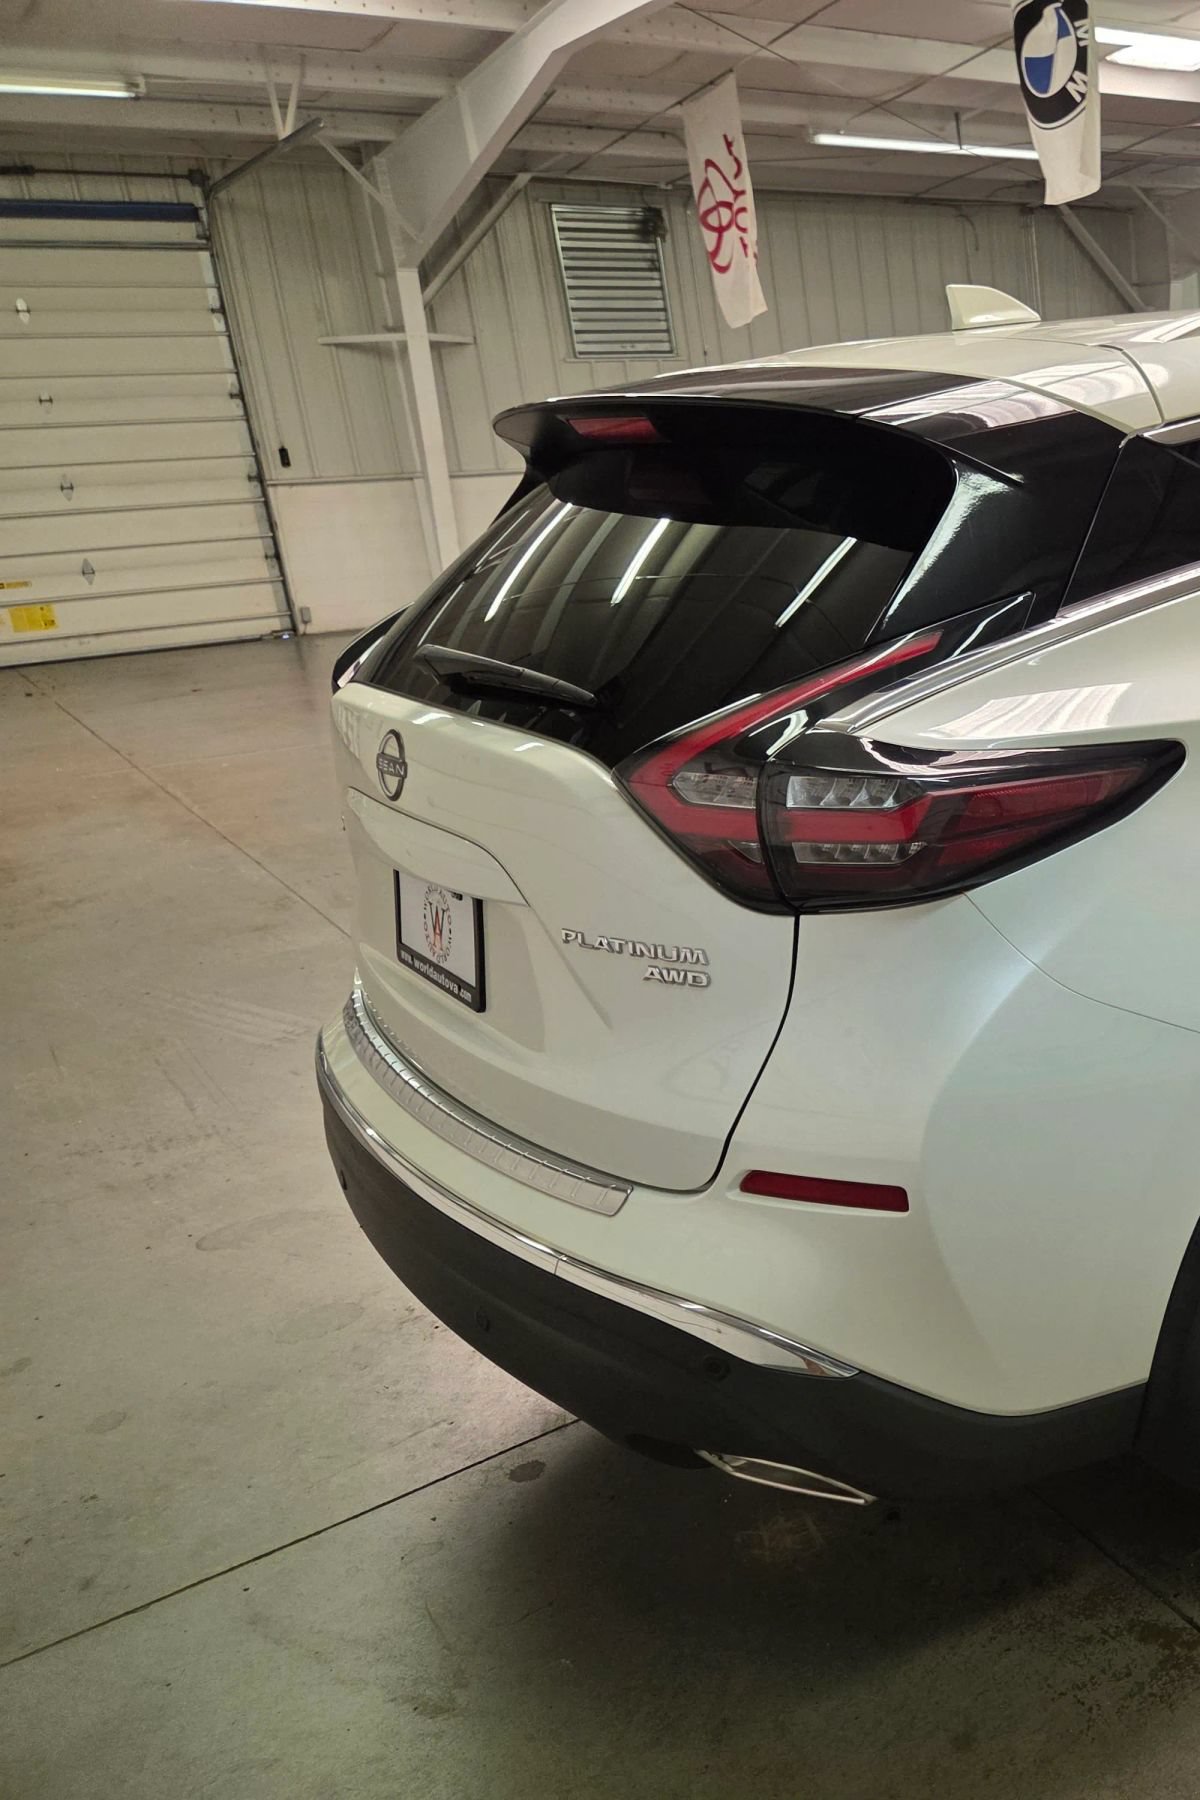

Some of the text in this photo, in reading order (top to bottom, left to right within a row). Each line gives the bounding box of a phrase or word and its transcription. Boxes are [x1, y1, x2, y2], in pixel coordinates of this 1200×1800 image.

[1065, 18, 1088, 103] MW
[561, 928, 709, 966] PLATINUM
[642, 965, 711, 988] AWD
